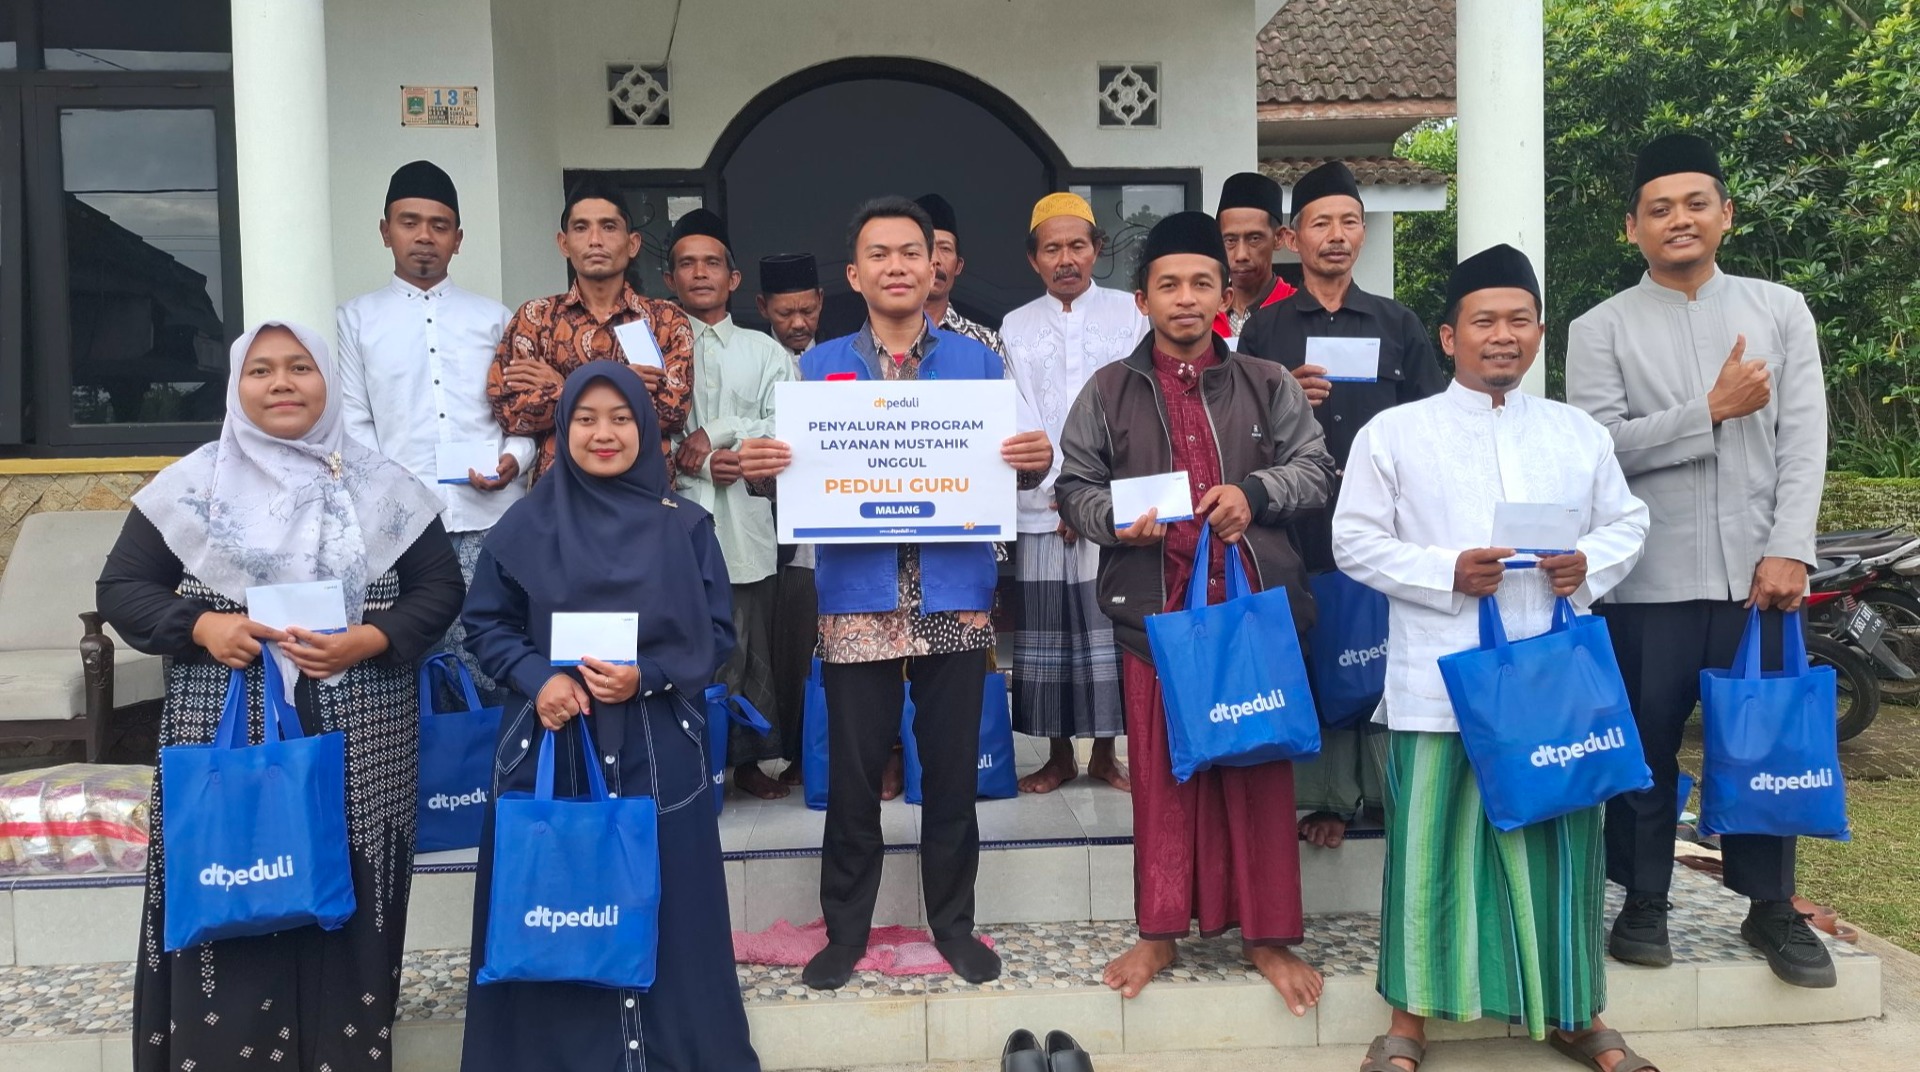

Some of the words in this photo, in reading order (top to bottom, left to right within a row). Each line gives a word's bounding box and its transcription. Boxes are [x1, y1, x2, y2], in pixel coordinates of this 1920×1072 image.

[873, 397, 919, 410] dtpeduli
[808, 421, 906, 431] PENYALURAN
[911, 420, 983, 431] PROGRAM
[821, 440, 890, 450] LAYANAN
[894, 438, 969, 449] MUSTAHIK
[867, 457, 927, 468] UNGGUL
[824, 479, 903, 494] PEDULI
[909, 477, 969, 493] GURU
[875, 505, 920, 515] MALANG
[1338, 638, 1388, 667] dtped
[1209, 689, 1285, 724] dtpeduli
[1530, 726, 1625, 767] dtpeduli
[1750, 768, 1833, 794] dtpeduli
[199, 855, 294, 892] dtpeduli
[524, 905, 619, 933] dtpeduli
